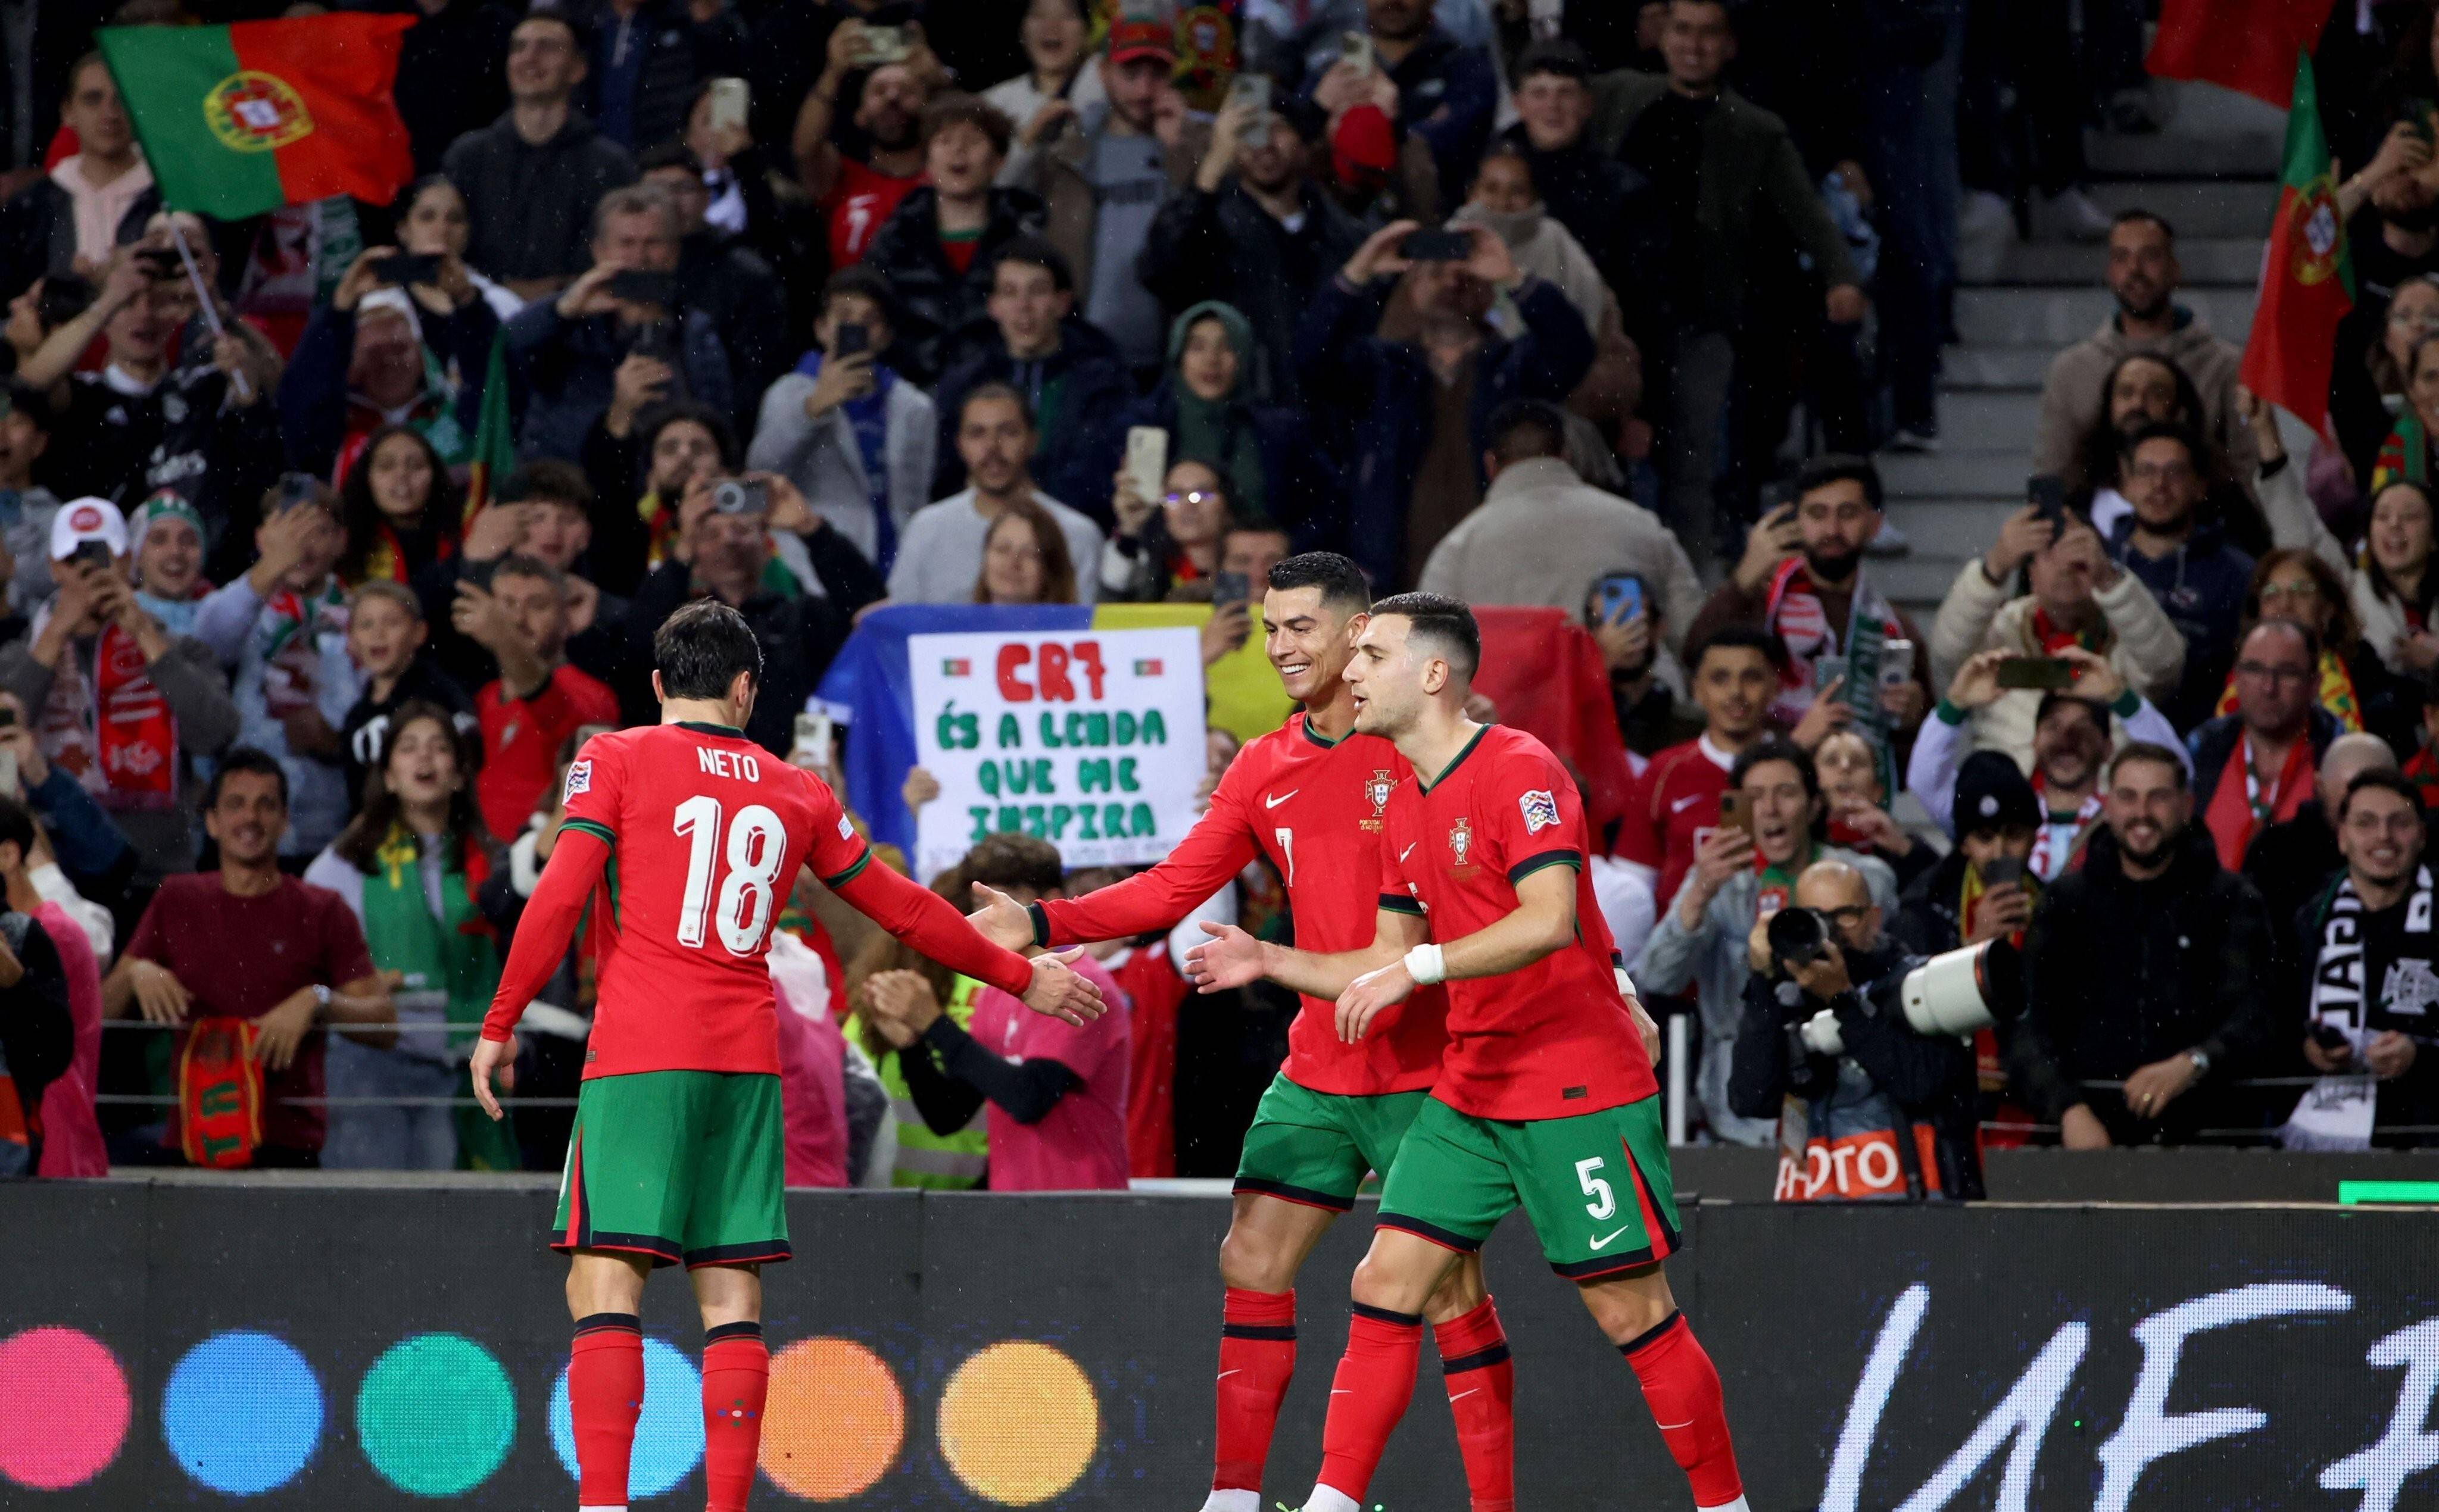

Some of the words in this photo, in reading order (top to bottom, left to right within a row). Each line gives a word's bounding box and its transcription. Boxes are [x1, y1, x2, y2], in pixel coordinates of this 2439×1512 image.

[996, 641, 1106, 702] CR7
[936, 700, 980, 750] ÉS
[997, 711, 1021, 748] A
[1039, 710, 1167, 748] LENDA
[696, 746, 760, 783] NETO
[978, 759, 1055, 799] QUE
[1078, 757, 1140, 793] ME
[968, 802, 1156, 842] INSPIRA
[673, 795, 787, 958] 18
[1275, 828, 1294, 888] 7
[1575, 1157, 1616, 1220] 5
